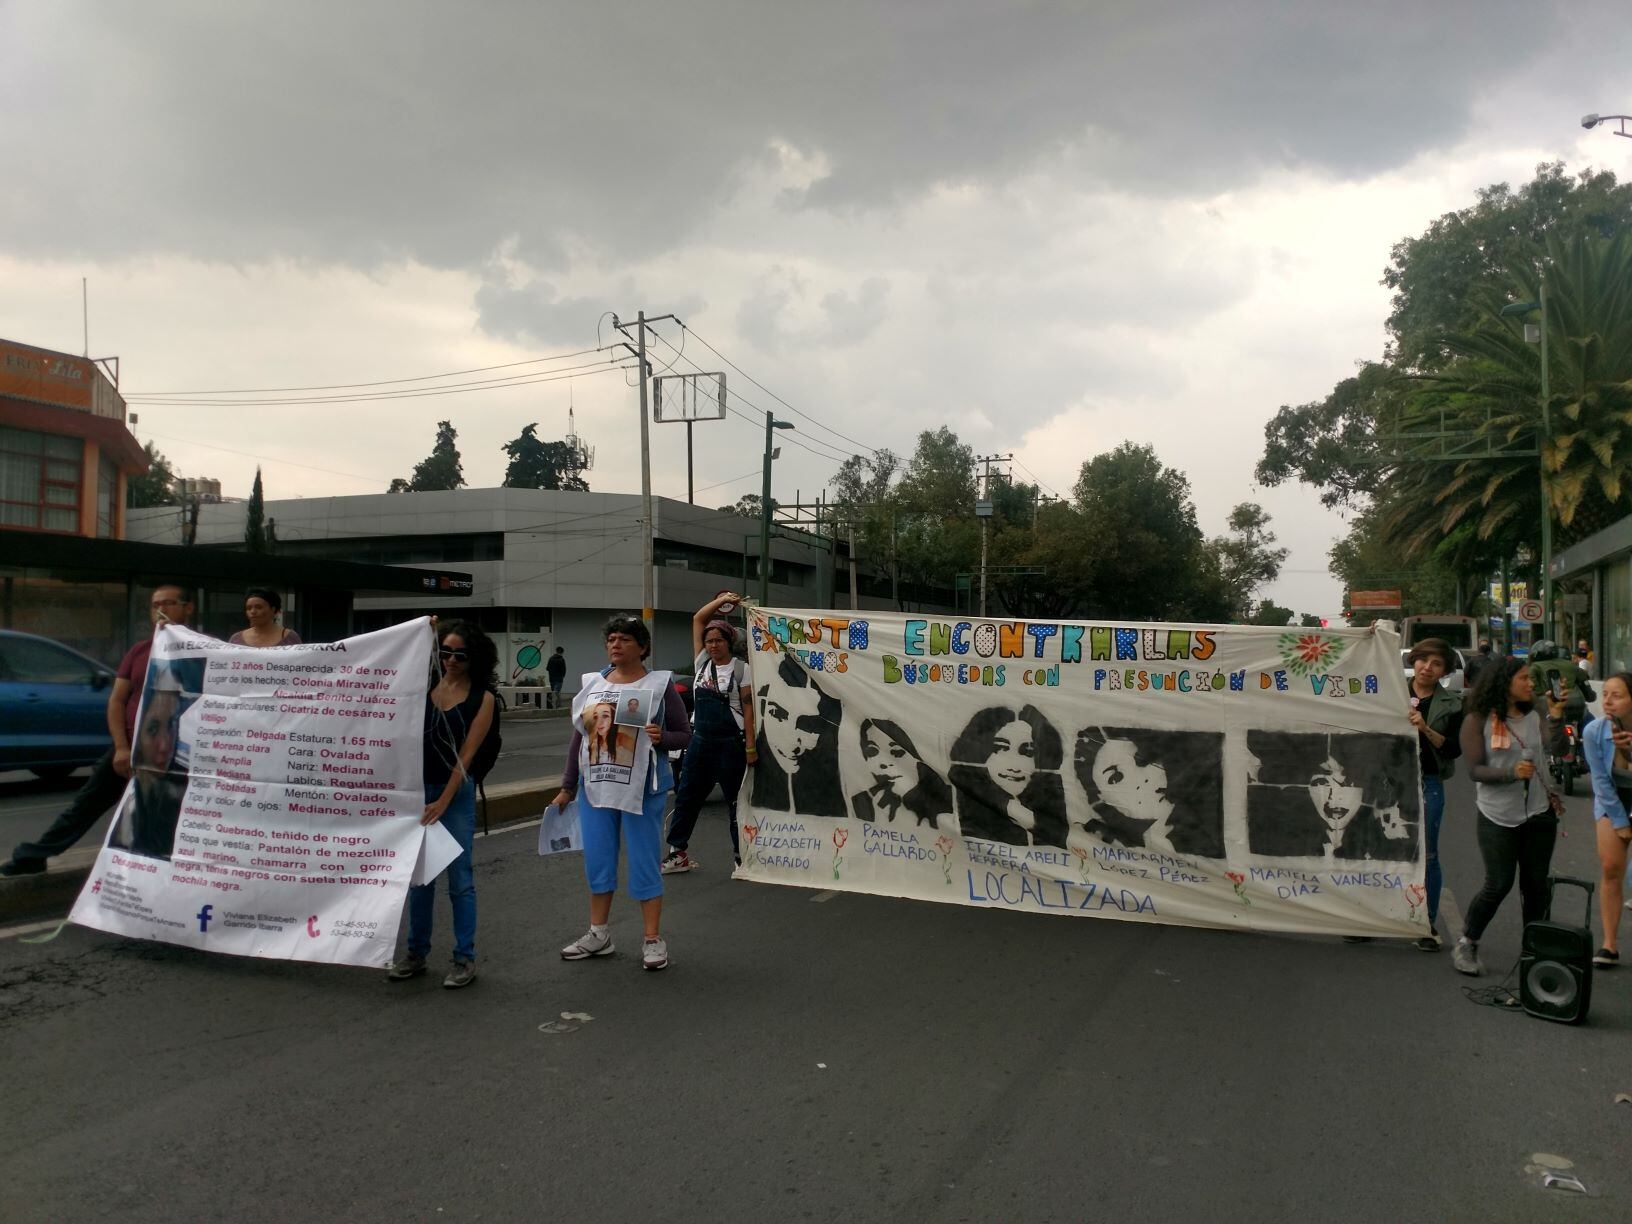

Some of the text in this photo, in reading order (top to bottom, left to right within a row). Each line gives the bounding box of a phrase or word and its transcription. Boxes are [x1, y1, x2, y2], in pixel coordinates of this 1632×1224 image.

[768, 616, 1217, 663] HASTA ENCONTRARLAS
[231, 661, 241, 670] 32
[243, 662, 264, 671] años
[266, 663, 336, 674] Desaparecida:
[340, 665, 353, 674] 30
[356, 666, 370, 675] de
[374, 668, 398, 676] nov
[882, 654, 1006, 687] BÚSQUEDAS
[1022, 663, 1060, 687] CON
[1094, 667, 1247, 693] PRESUNCIÓN
[1260, 670, 1289, 690] DE
[1310, 674, 1378, 698] VIDA
[229, 676, 240, 684] de
[241, 676, 253, 684] los
[255, 677, 289, 686] hechos:
[292, 677, 333, 688] Colonia
[336, 679, 390, 690] Miravalle
[317, 692, 352, 703] Benito
[356, 694, 396, 705] Juárez
[280, 704, 319, 714] Cicatriz
[322, 706, 335, 715] de
[338, 708, 385, 718] cesárea
[389, 712, 396, 720] y
[212, 741, 244, 751] Morena
[246, 744, 271, 753] clara
[246, 730, 286, 741] Delgada
[290, 732, 336, 744] Estatura:
[341, 736, 366, 746] 1.65
[369, 739, 392, 748] mts
[221, 755, 252, 766] Amplia
[288, 747, 370, 761] Cara: Ovalada
[288, 761, 374, 775] Nariz: Mediana
[215, 781, 256, 794] Pobladas
[287, 775, 396, 790] Labios: Regulares
[285, 788, 388, 803] Mentón: Ovalado
[184, 806, 222, 818] obscuros
[240, 799, 252, 808] de
[257, 801, 281, 811] ojos:
[288, 803, 352, 816] Medianos,
[360, 808, 396, 817] cafés
[753, 816, 805, 833] VIVIANA
[271, 831, 309, 841] teñido
[313, 833, 328, 842] de
[333, 836, 370, 846] negro
[863, 823, 919, 844] PAMELA
[202, 838, 219, 846] que
[258, 843, 310, 856] Pantalón
[316, 848, 331, 857] de
[337, 849, 396, 858] mezclilla
[754, 836, 821, 851] ELIZABETH
[863, 838, 937, 862] GALLARDO
[178, 847, 195, 856] azul
[203, 851, 239, 864] marino,
[250, 857, 307, 869] chamarra
[360, 863, 392, 872] gorro
[756, 851, 810, 870] GARRIDO
[965, 840, 1071, 867] ITZEL ARELI
[969, 853, 1031, 874] HERRERA
[172, 874, 242, 892] mochila negra.
[231, 869, 270, 880] negros
[274, 874, 296, 882] con
[300, 876, 335, 884] suela
[340, 876, 378, 885] blanca
[381, 879, 388, 887] y
[1250, 867, 1403, 889] MARIELA VANESSA
[967, 870, 1158, 916] LOCALIZADA
[1278, 881, 1324, 900] DÍAZ
[257, 913, 297, 924] Elizabeth
